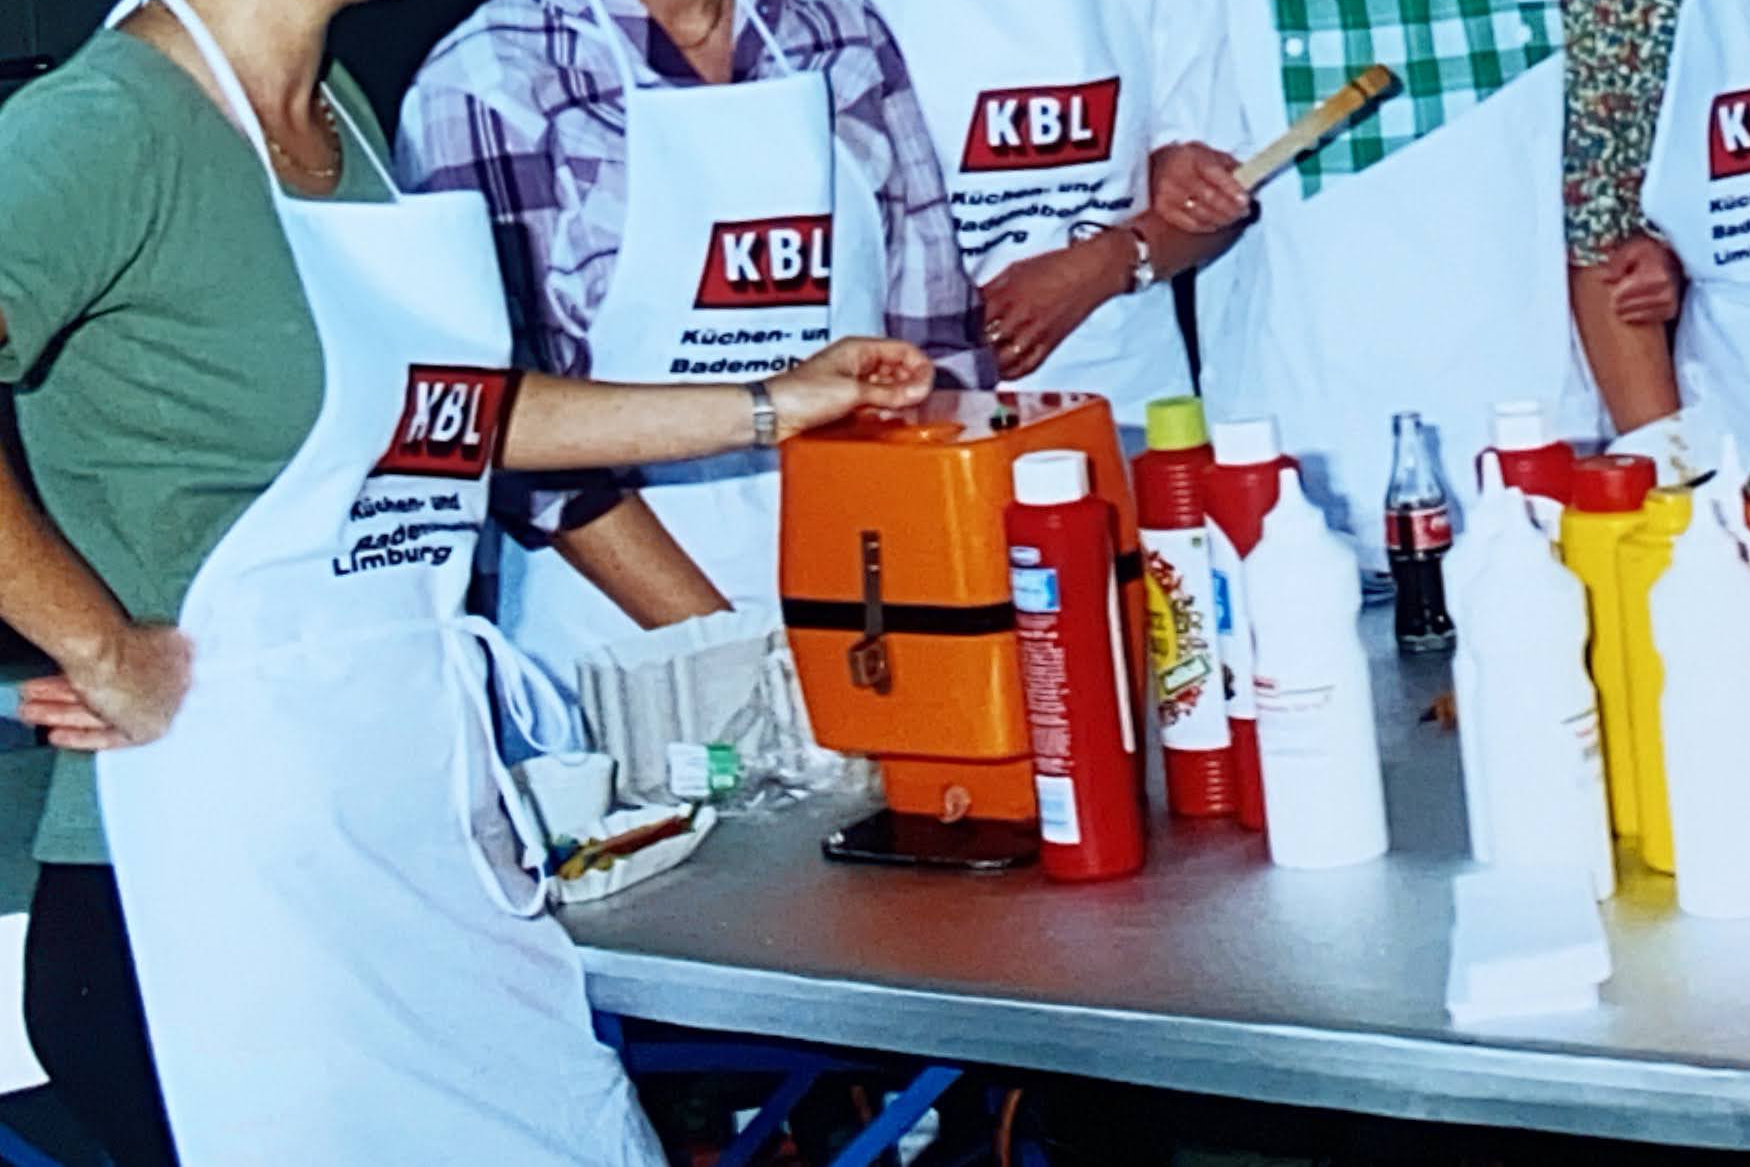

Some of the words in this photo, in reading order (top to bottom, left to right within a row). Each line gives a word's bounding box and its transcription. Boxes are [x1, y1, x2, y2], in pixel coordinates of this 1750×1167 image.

[985, 95, 1094, 148] KBL
[722, 228, 830, 282] KBL
[681, 328, 792, 346] Küchen-
[801, 327, 830, 342] un
[406, 381, 484, 445] KBL
[333, 545, 452, 576] Limburg
